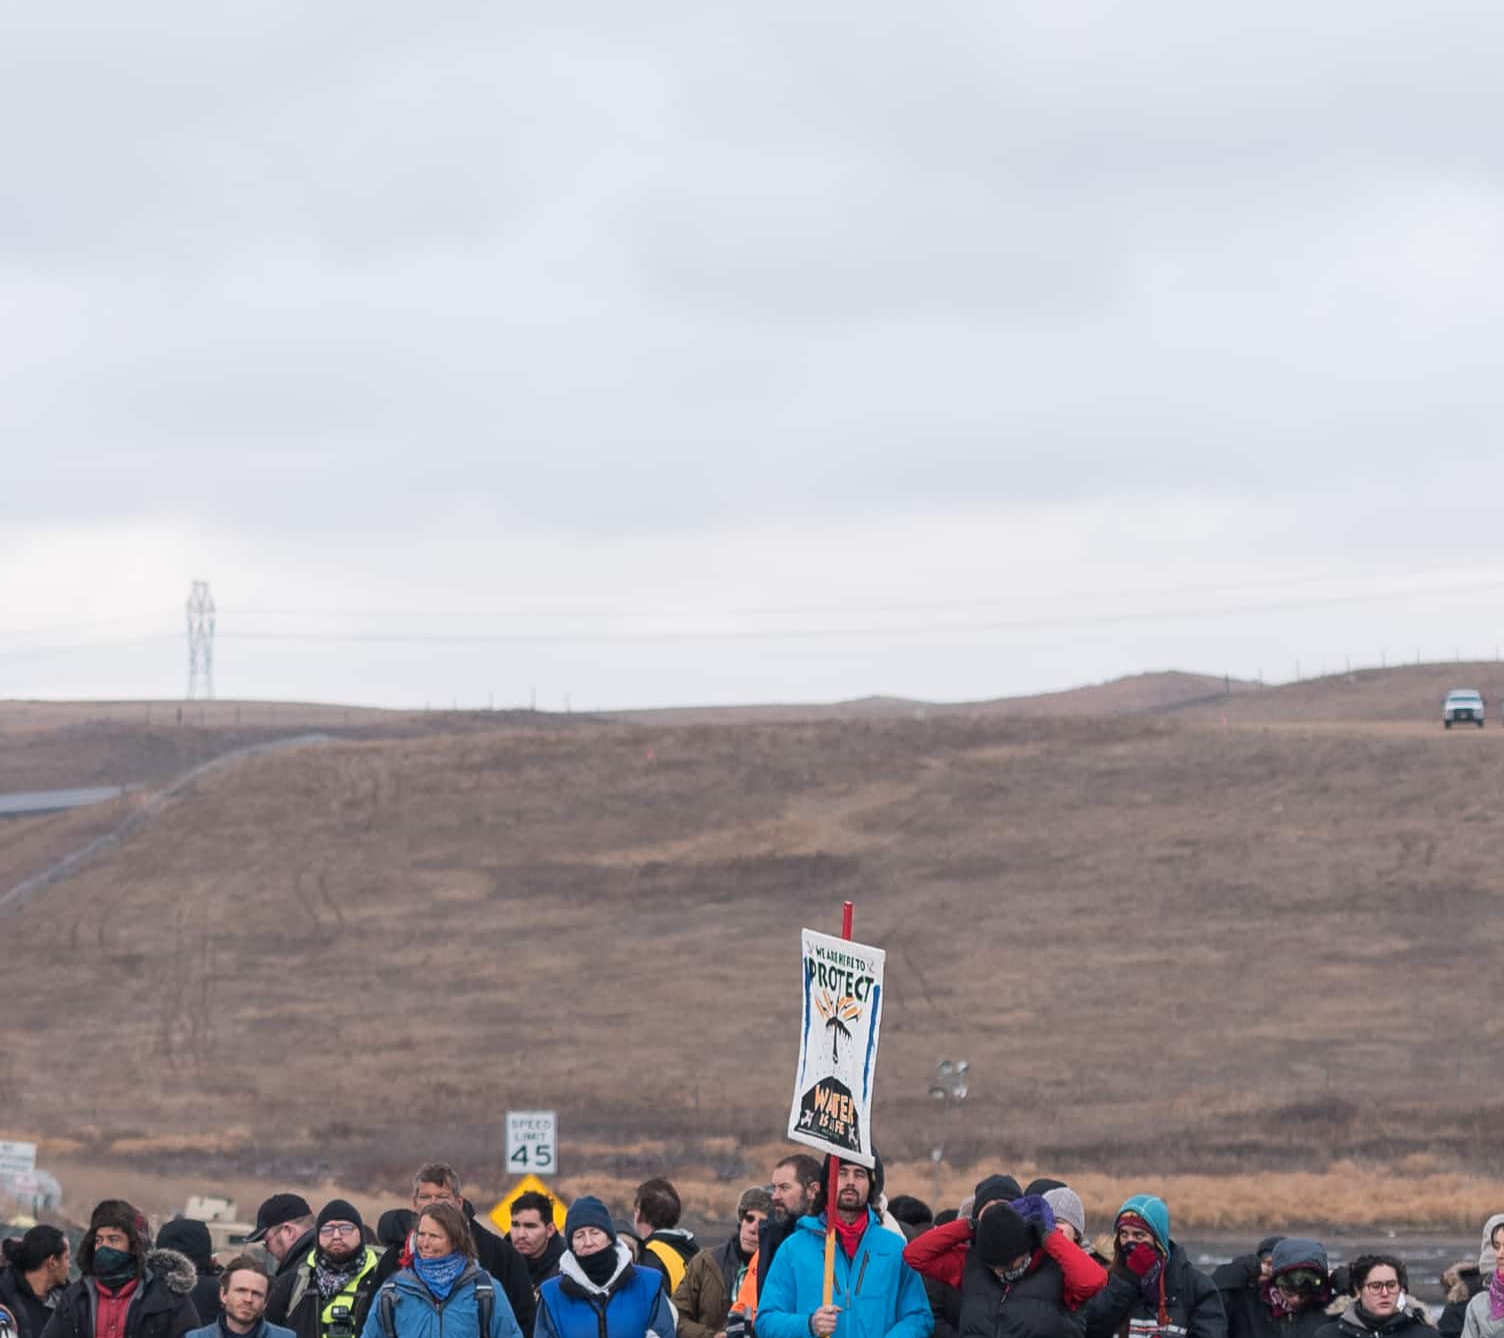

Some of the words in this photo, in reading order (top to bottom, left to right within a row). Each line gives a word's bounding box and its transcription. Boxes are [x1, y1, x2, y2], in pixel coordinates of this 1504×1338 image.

[816, 945, 825, 959] WE
[856, 958, 865, 971] TO
[809, 957, 874, 1002] PROTECT
[814, 1084, 854, 1125] WATER
[511, 1119, 552, 1131] SPEED
[819, 1113, 829, 1127] IS
[514, 1132, 547, 1141] LIMIT
[511, 1145, 552, 1166] 45
